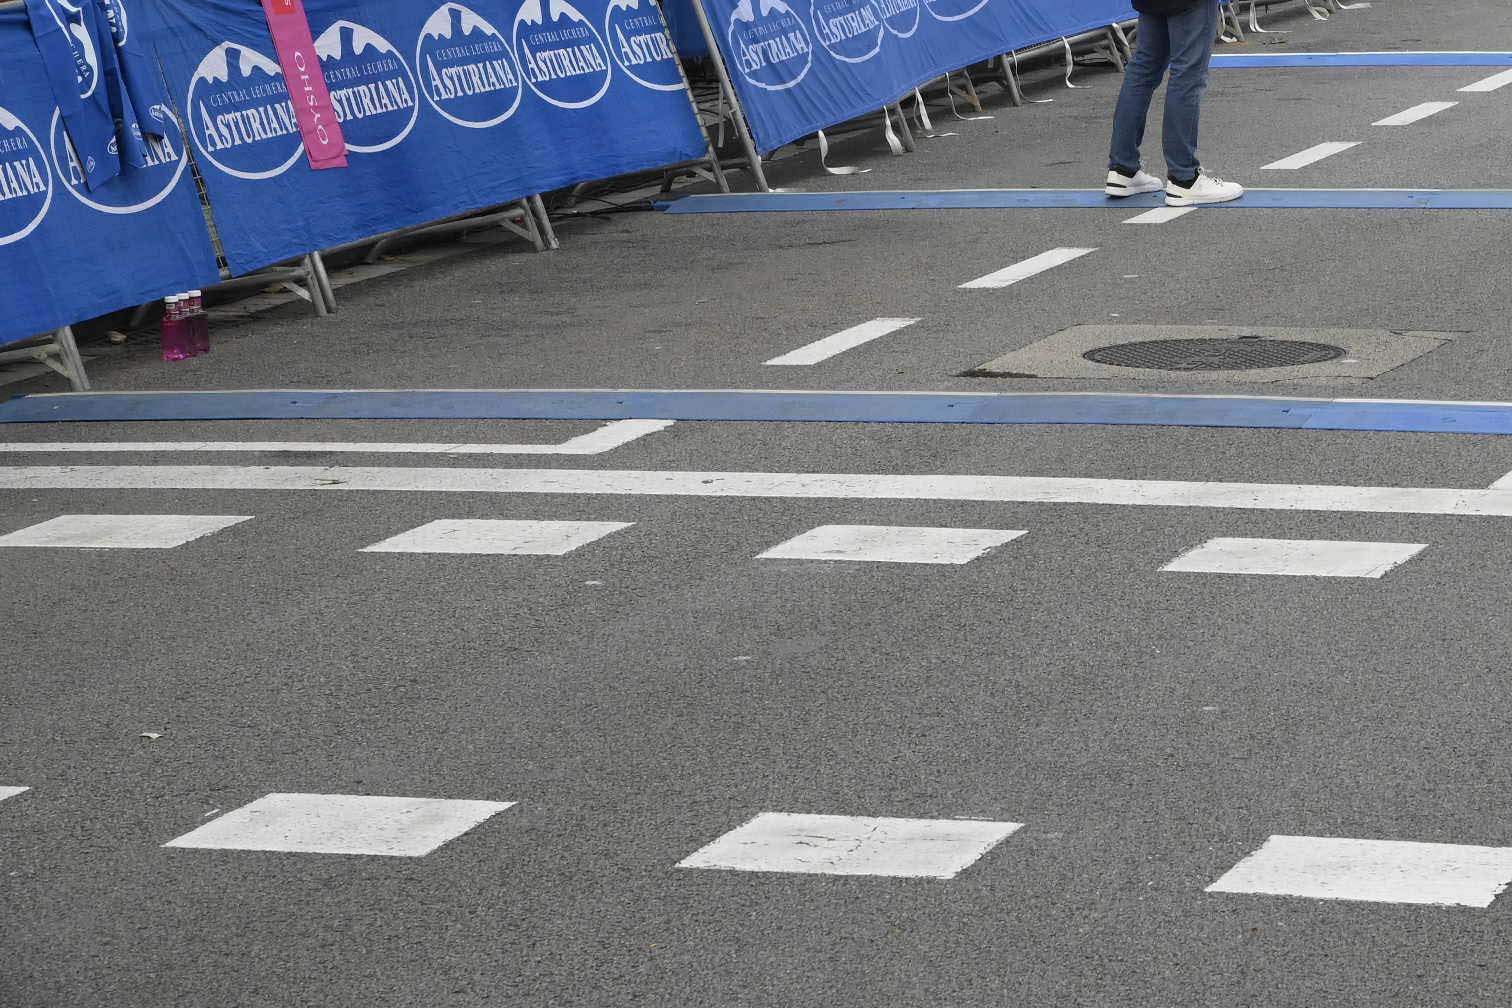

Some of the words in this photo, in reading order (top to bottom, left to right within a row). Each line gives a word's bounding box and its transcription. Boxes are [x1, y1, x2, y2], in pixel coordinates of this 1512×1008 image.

[529, 31, 559, 44] CENTRAL
[560, 27, 590, 41] LECHERA
[362, 58, 399, 75] LECHERA
[436, 45, 470, 60] CENTRAL
[521, 38, 607, 83] ASTURIANA
[426, 53, 518, 102] ASTURIANA
[210, 90, 249, 107] CENTRAL
[294, 51, 329, 145] OYSHO
[331, 75, 414, 124] STURIANA
